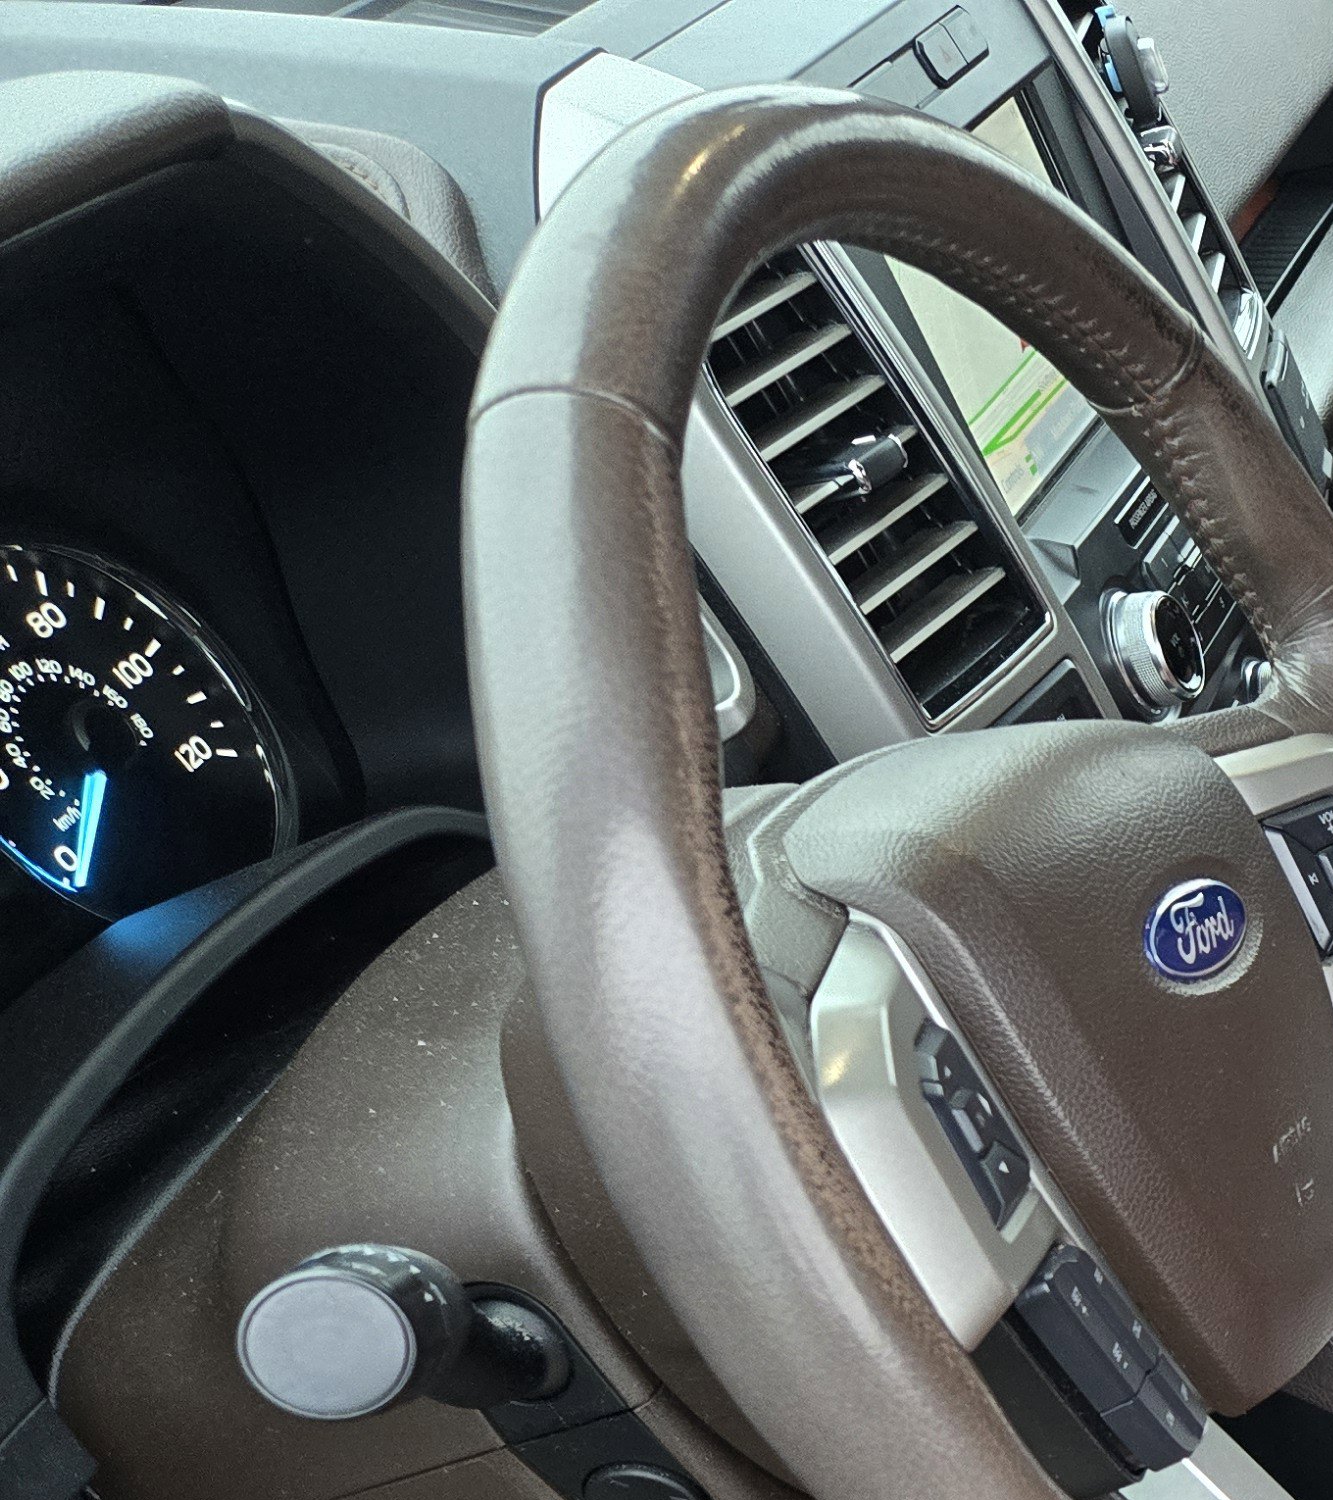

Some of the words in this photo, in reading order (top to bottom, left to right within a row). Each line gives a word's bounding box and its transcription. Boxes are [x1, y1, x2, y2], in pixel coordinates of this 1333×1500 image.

[26, 602, 67, 638] 80
[8, 661, 33, 681] 100
[35, 658, 63, 675] 120
[68, 664, 95, 686] 140
[112, 652, 154, 690] 100
[102, 684, 129, 709] 160
[130, 713, 154, 739] 180
[5, 743, 28, 769] 40
[174, 735, 212, 772] 120
[29, 776, 55, 800] 20
[53, 845, 78, 872] 0
[1170, 892, 1234, 964] Ford
